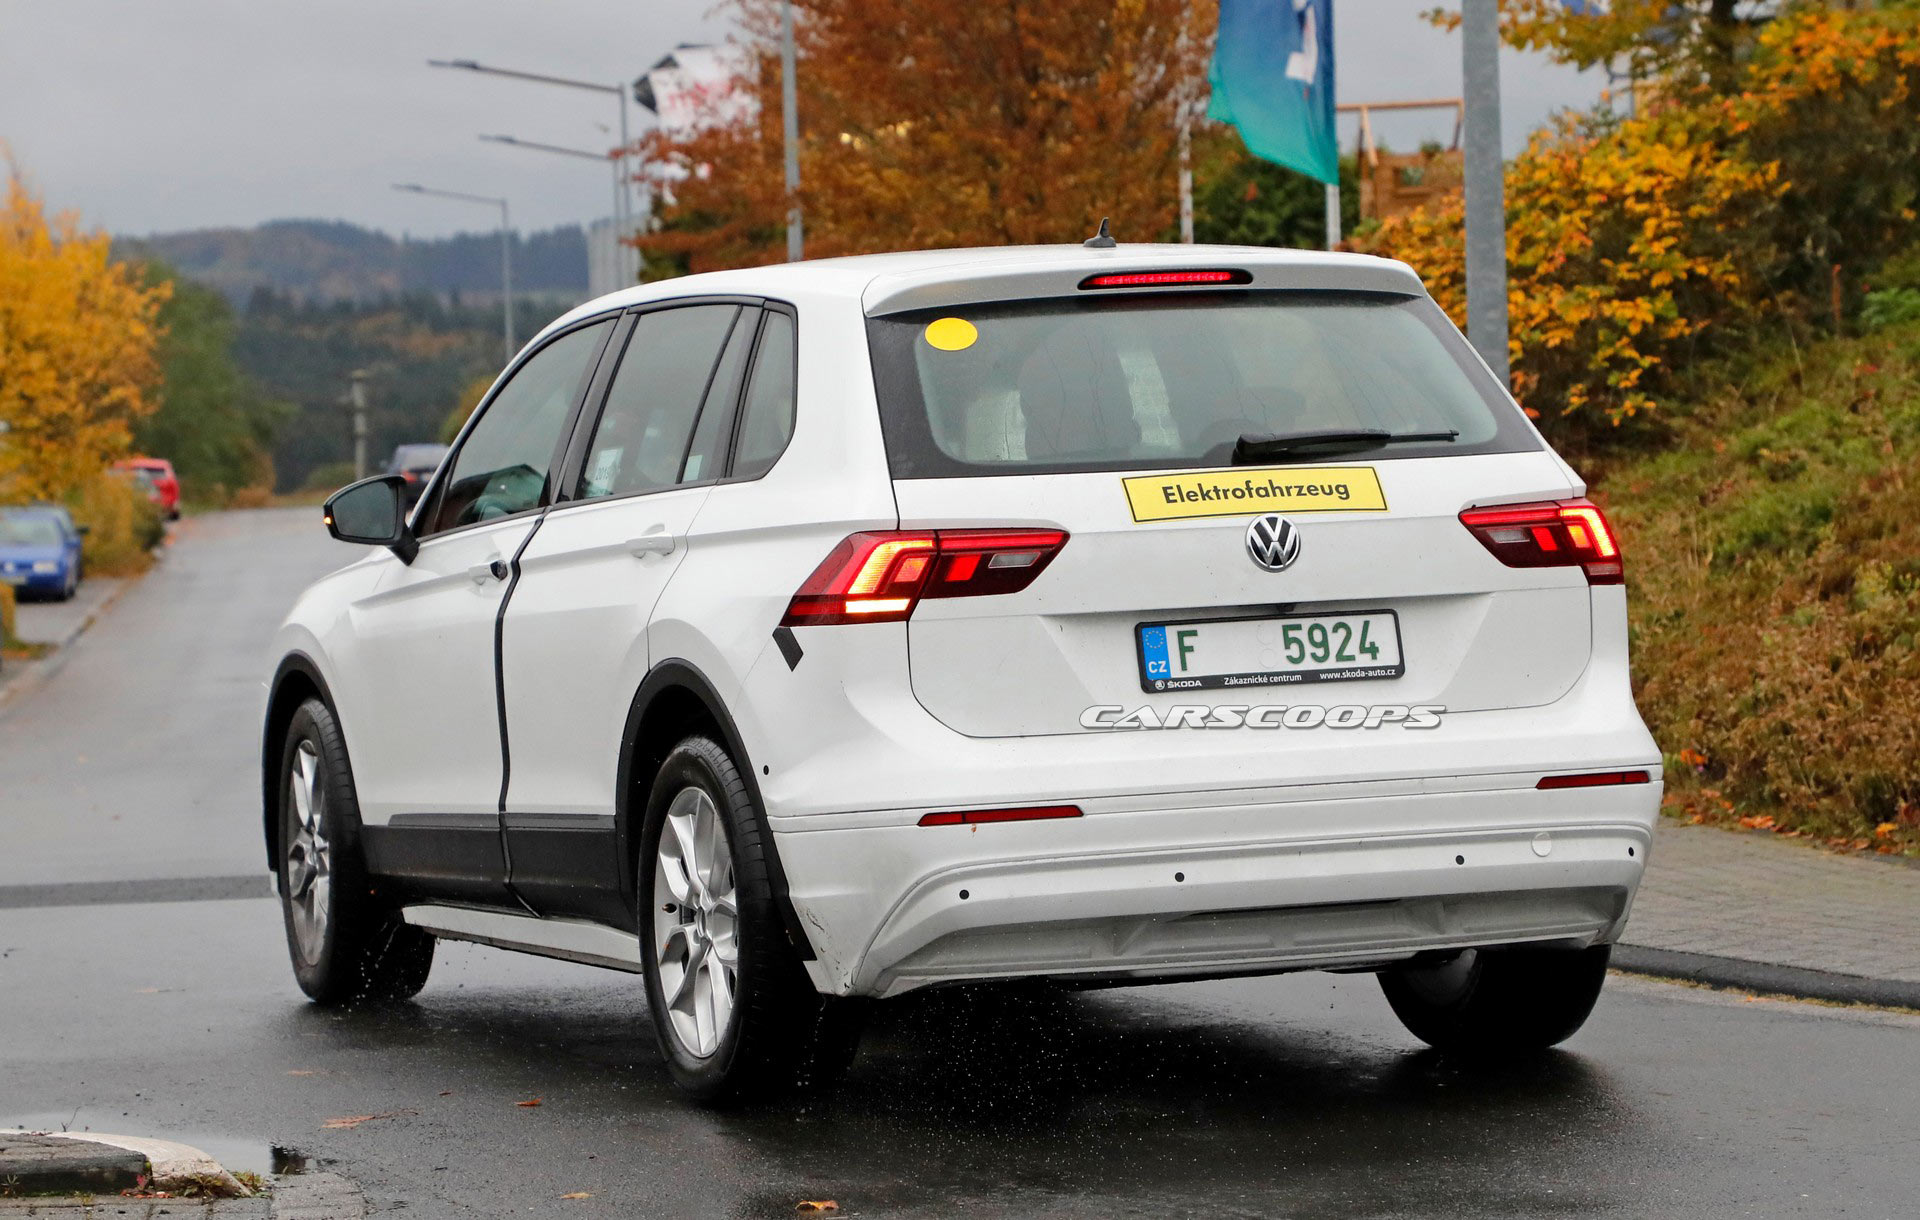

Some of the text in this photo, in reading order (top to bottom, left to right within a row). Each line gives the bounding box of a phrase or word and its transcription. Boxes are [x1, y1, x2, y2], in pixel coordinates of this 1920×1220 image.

[1162, 480, 1350, 503] Elektrofahrzeug
[1177, 620, 1379, 671] F 5924
[1148, 661, 1167, 673] CZ
[1224, 673, 1302, 685] Zákaznické centrum
[1320, 668, 1396, 679] www.skoda-auto.cz
[1167, 679, 1202, 689] ŠKODA
